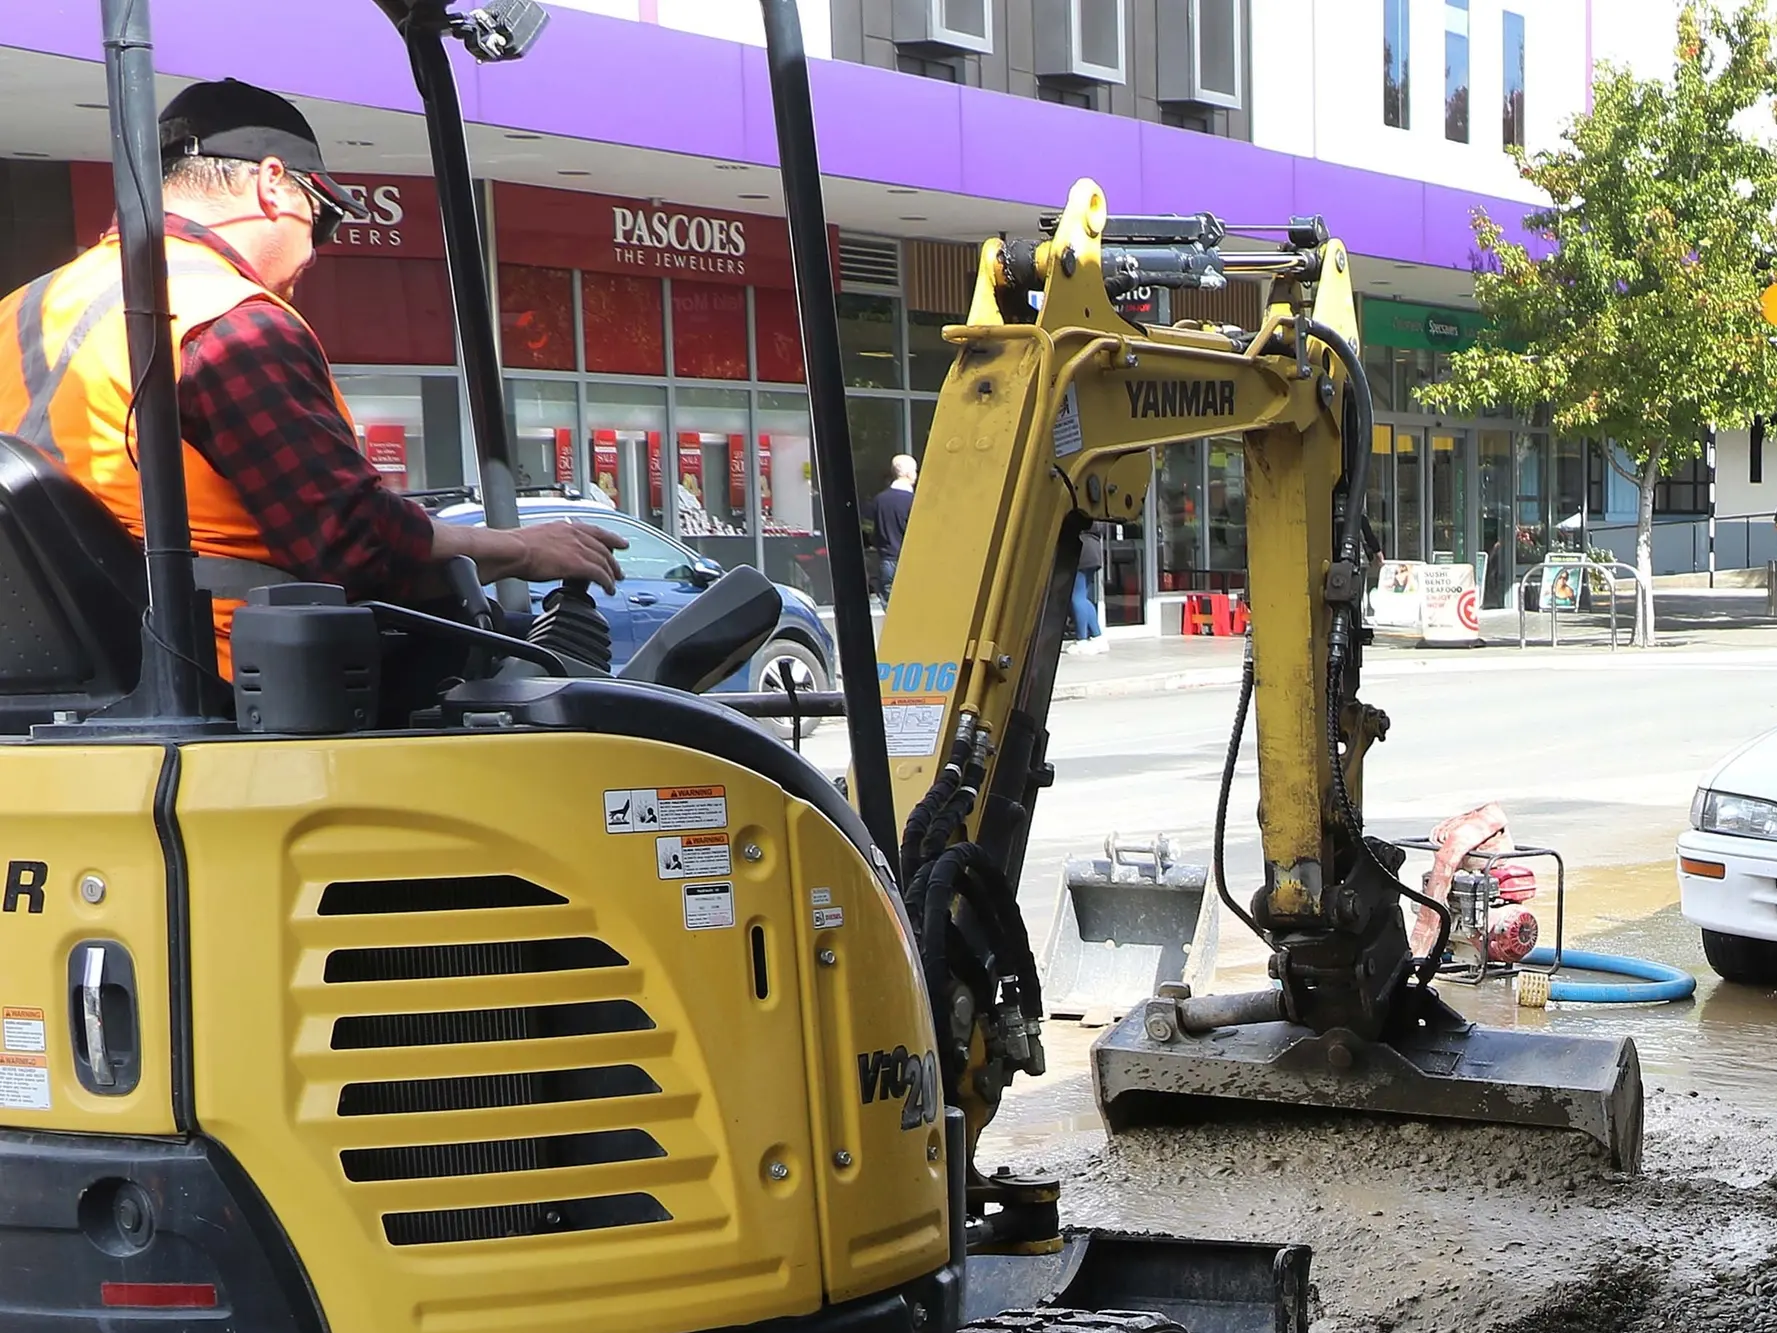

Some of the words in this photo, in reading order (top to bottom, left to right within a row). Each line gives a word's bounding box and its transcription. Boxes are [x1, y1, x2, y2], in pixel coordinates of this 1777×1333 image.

[612, 206, 746, 257] PASCOES
[615, 247, 646, 266] THE
[655, 252, 746, 276] JEWELLERS
[1125, 380, 1236, 419] YANMAR
[678, 789, 712, 797] WARNING
[11, 1010, 41, 1018] WARNING
